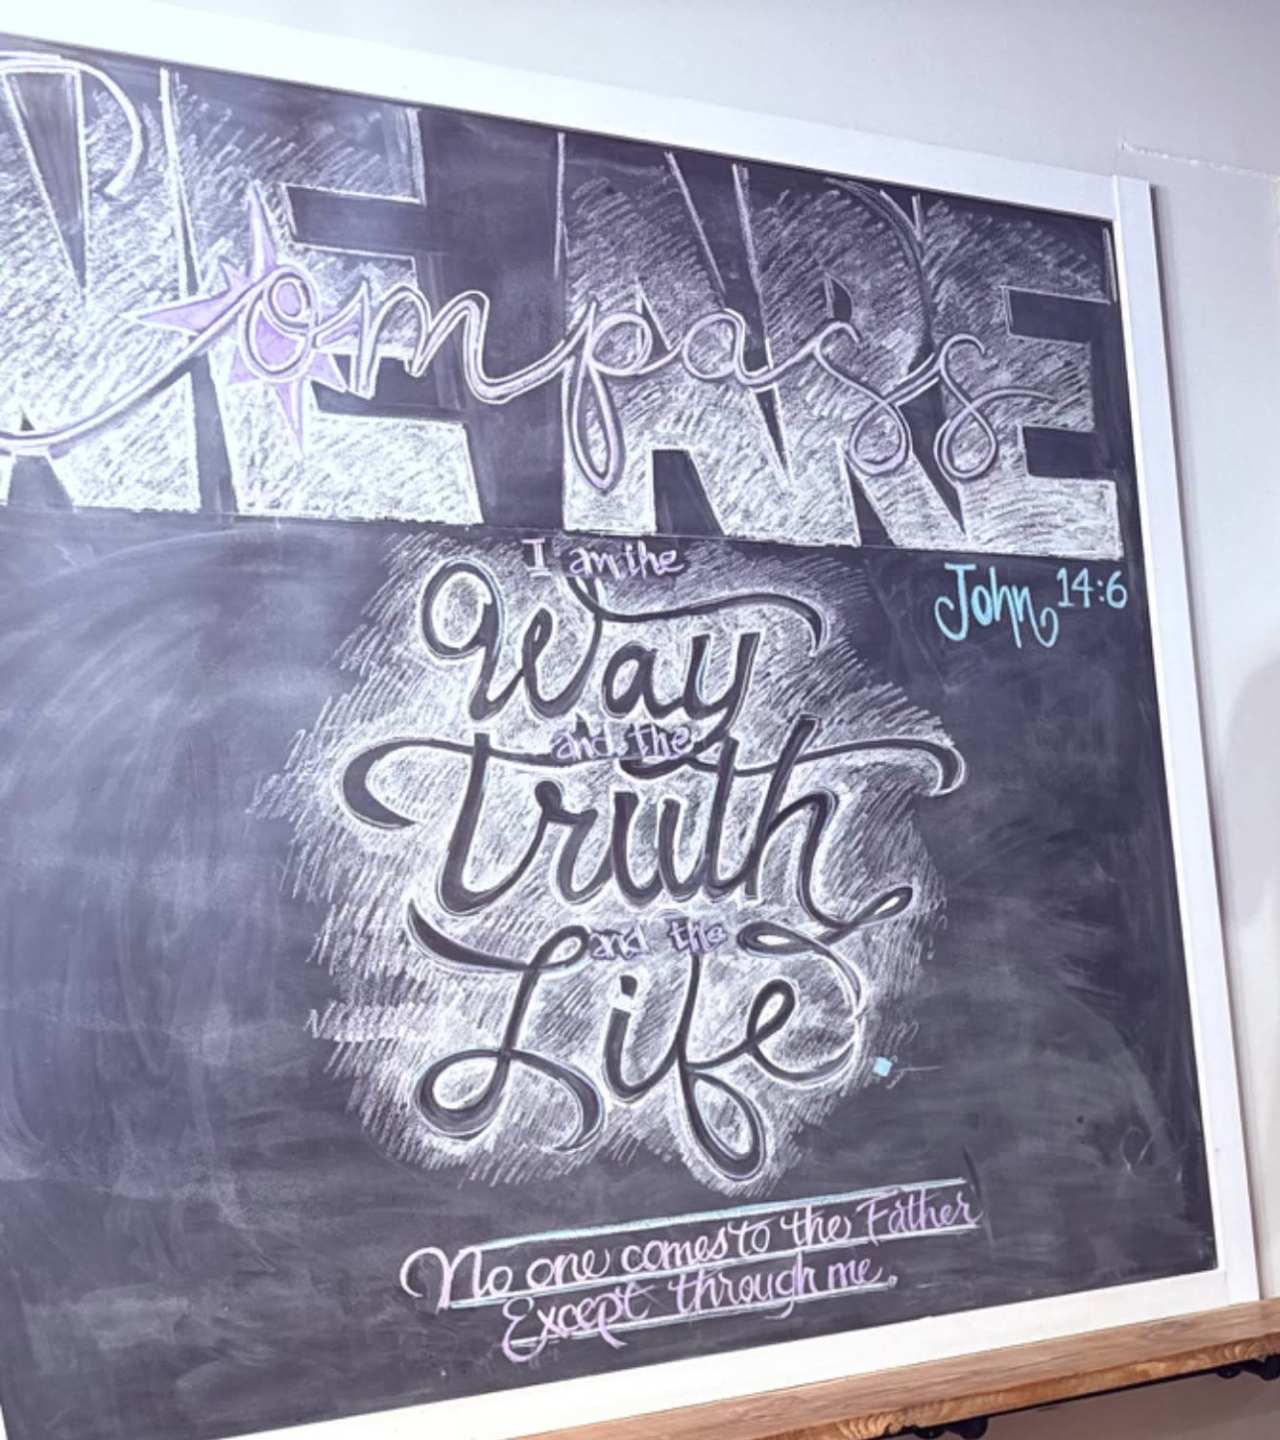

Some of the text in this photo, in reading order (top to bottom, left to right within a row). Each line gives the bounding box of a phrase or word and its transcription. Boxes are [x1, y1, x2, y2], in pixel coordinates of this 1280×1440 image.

[935, 562, 1129, 648] John 14:6
[420, 560, 826, 778] Way
[406, 898, 862, 1182] Life
[400, 1246, 512, 1311] No
[526, 1247, 611, 1291] one
[619, 1237, 726, 1272] comes
[779, 1207, 854, 1246] the
[856, 1184, 984, 1245] Father
[502, 1280, 656, 1362] Except
[667, 1257, 818, 1321] through
